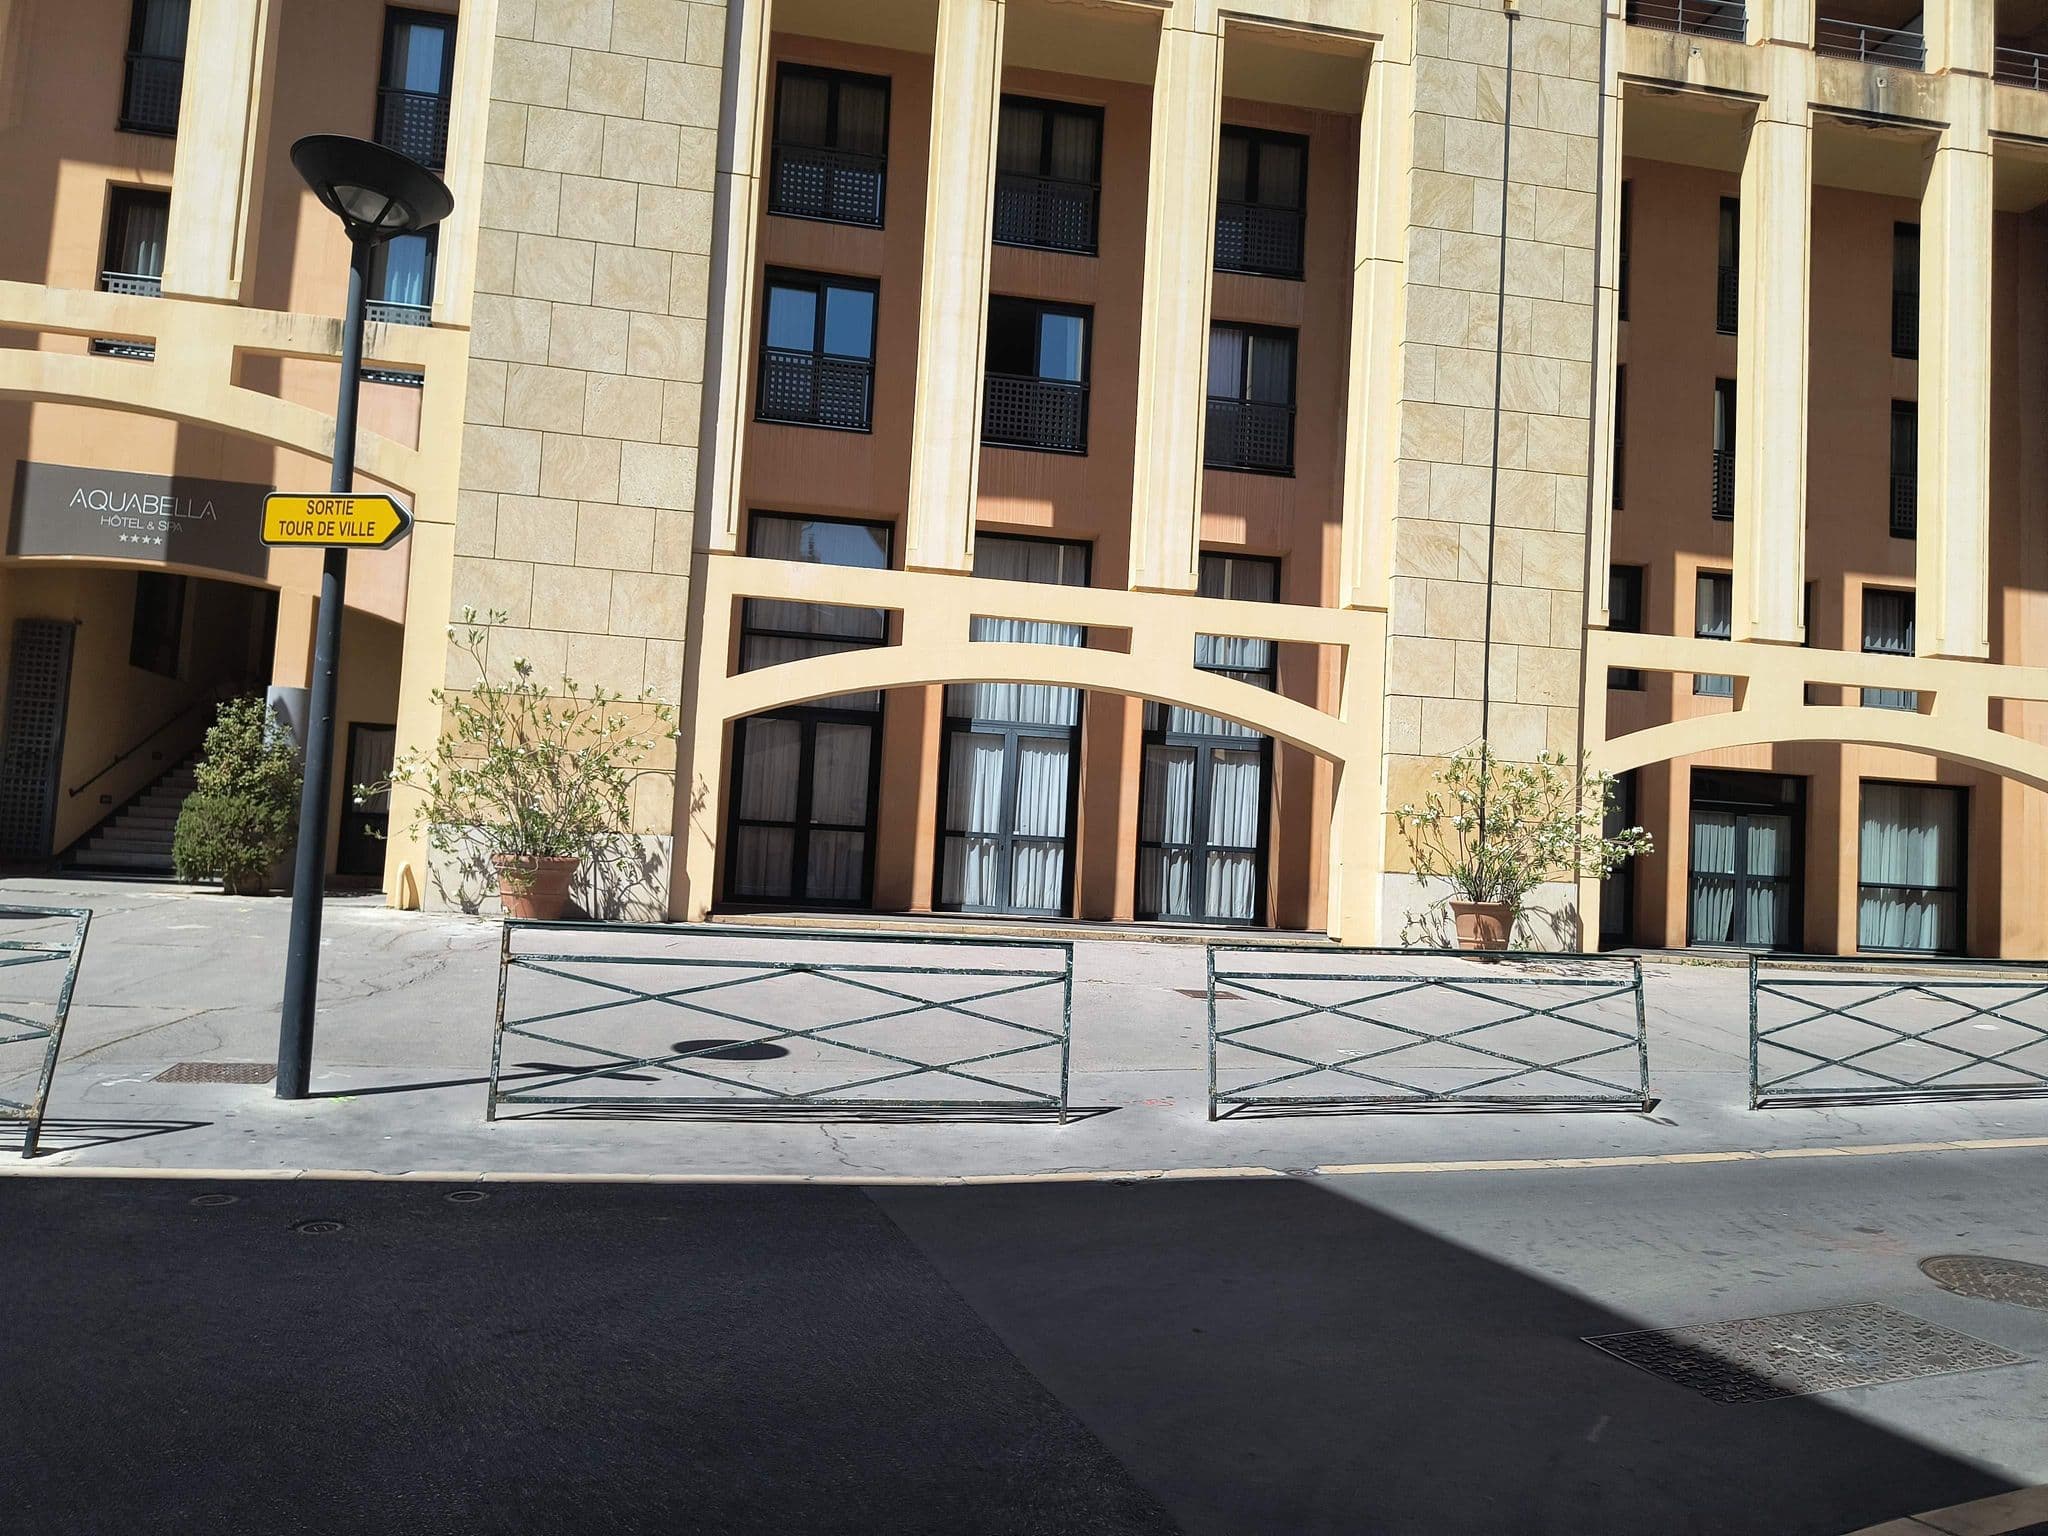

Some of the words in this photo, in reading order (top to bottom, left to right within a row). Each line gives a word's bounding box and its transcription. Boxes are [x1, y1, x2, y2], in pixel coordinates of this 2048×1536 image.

[69, 487, 217, 521] AQUABELLA
[306, 499, 355, 515] SORTIE
[146, 520, 155, 531] &
[157, 519, 183, 533] SPA
[278, 520, 314, 537] TOUR
[317, 521, 336, 537] DE
[339, 521, 376, 537] VILLE
